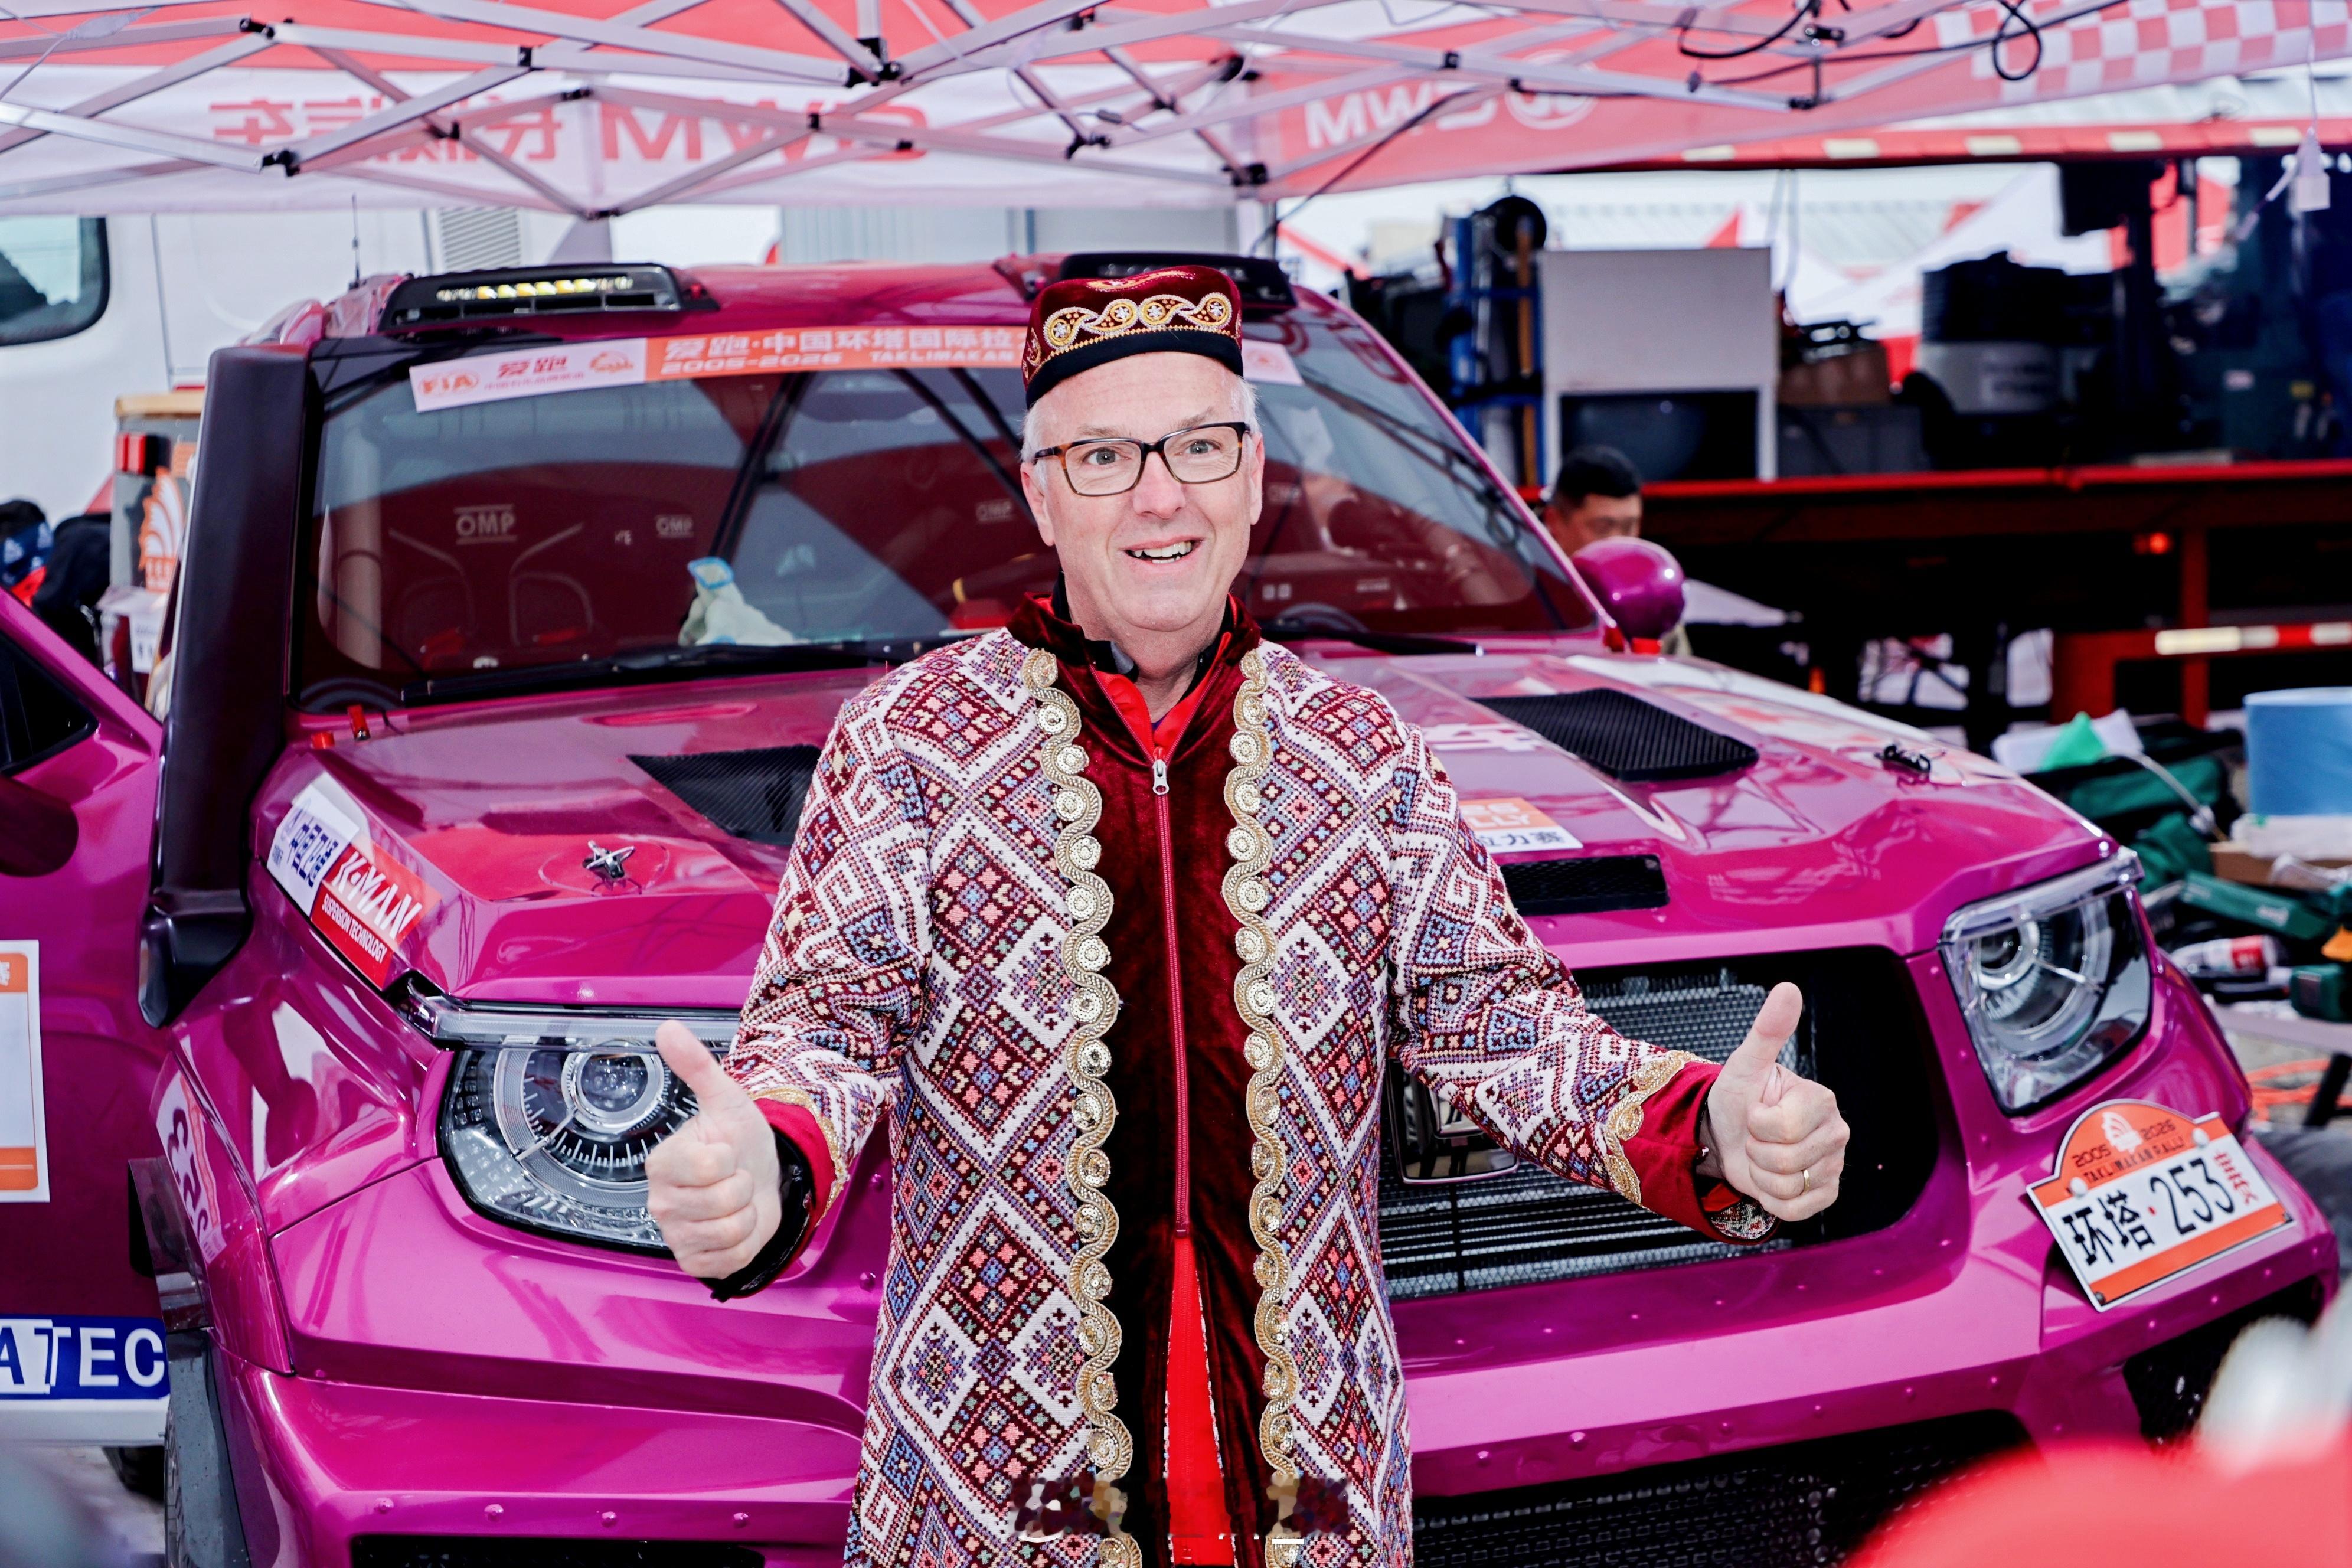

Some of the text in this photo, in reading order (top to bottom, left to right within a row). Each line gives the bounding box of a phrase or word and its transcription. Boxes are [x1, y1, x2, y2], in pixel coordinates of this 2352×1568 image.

[421, 374, 472, 394] FIA
[456, 511, 515, 535] OMP
[656, 517, 693, 535] OMP
[322, 893, 387, 964] SUSPENSION TECHNOLOGY
[2072, 1144, 2112, 1167] 2005
